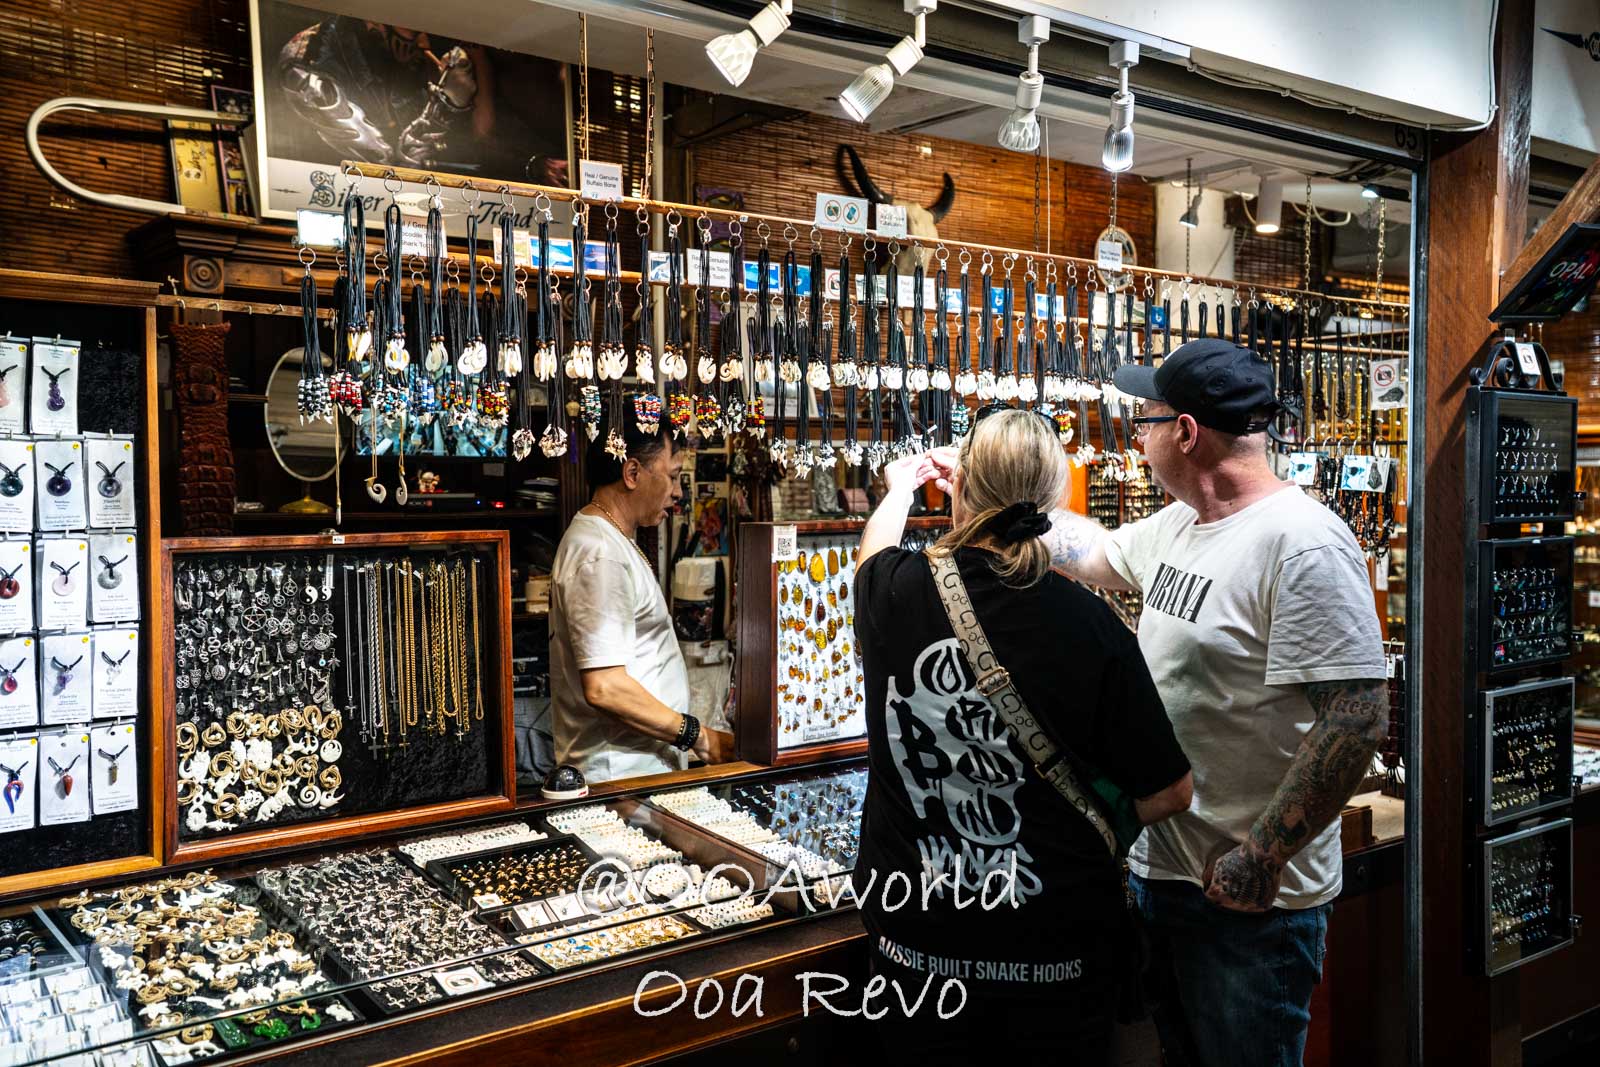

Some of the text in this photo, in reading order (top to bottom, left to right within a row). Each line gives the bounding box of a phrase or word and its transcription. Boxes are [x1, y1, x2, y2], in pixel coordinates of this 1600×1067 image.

[1550, 260, 1593, 280] OPAL
[1145, 562, 1213, 623] NRVANA
[878, 935, 1082, 983] AUSSIE BUILT SNAKE HOOKS
